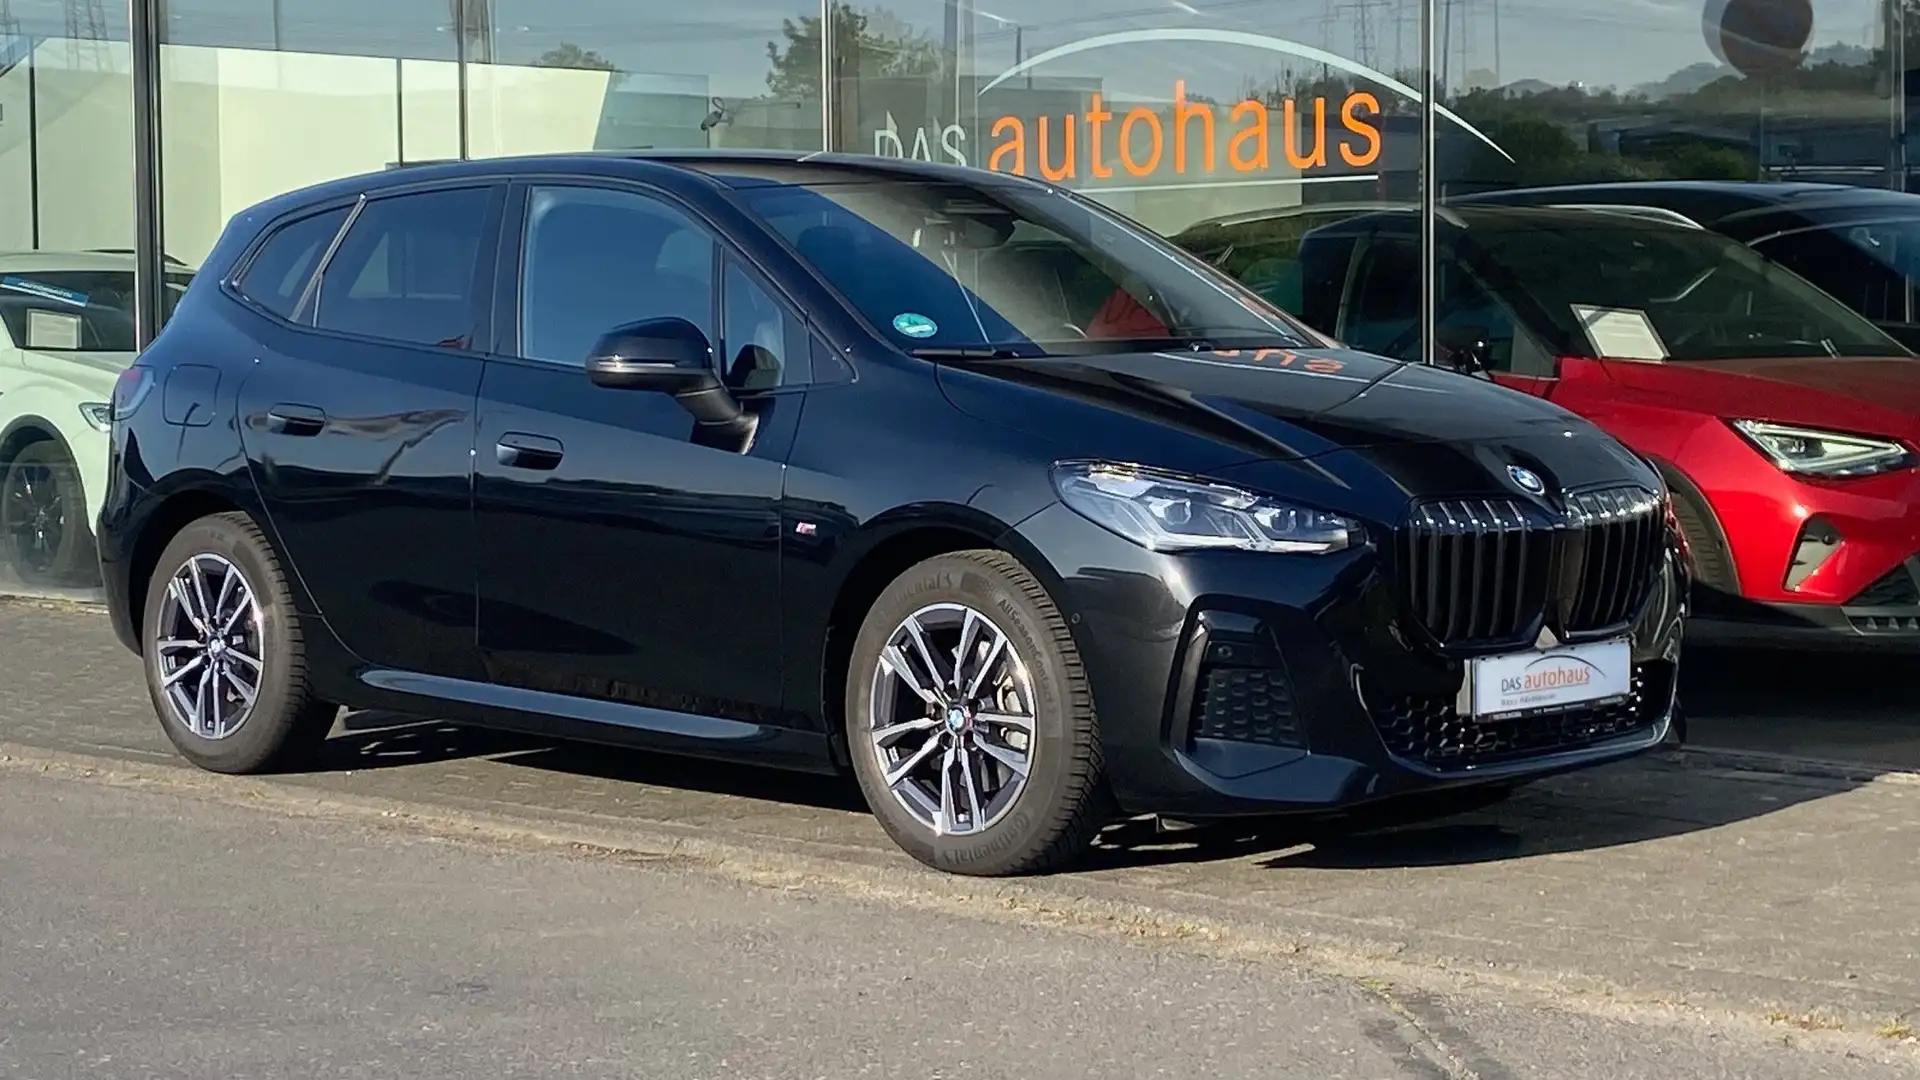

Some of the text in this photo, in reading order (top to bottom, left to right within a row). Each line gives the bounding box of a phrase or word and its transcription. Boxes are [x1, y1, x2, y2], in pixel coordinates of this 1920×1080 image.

[989, 79, 1382, 181] autohaus
[1501, 666, 1590, 692] DAS autohaus
